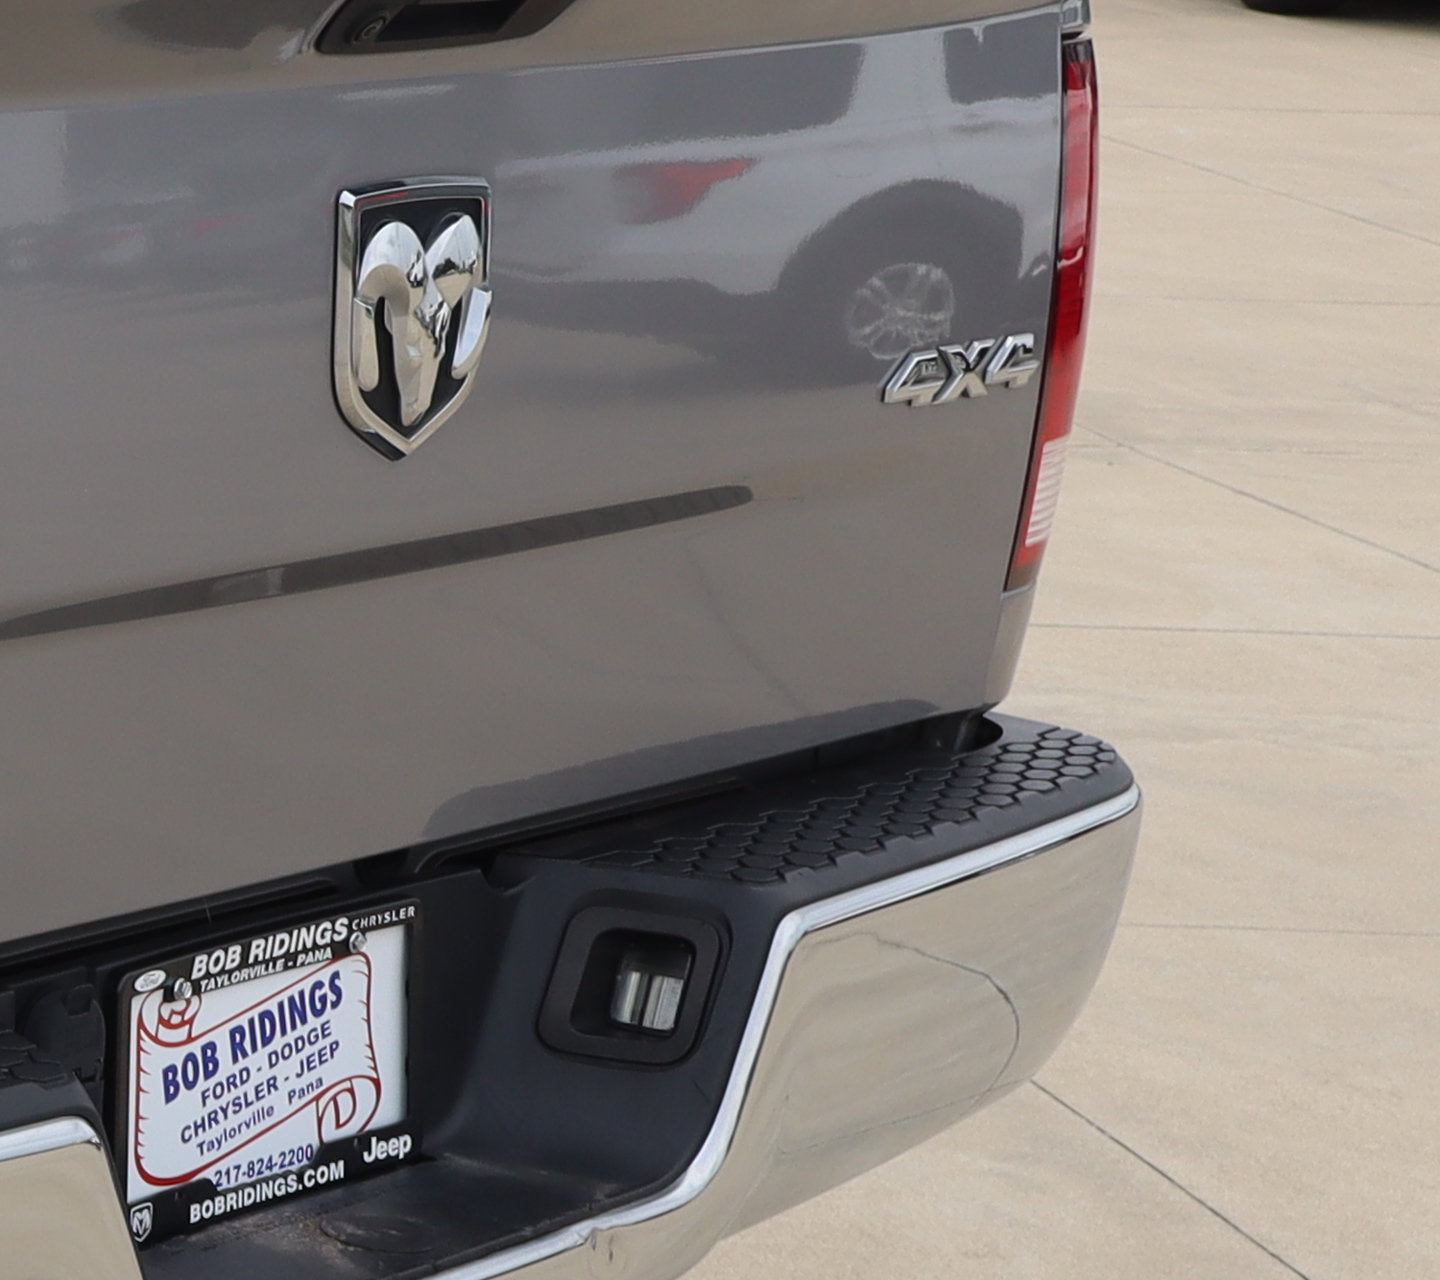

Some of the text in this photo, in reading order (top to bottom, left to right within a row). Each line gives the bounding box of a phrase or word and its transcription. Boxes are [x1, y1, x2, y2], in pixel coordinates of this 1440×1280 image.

[191, 917, 350, 980] BOB RIDINGS
[351, 905, 416, 932] CHRYSLER
[199, 961, 285, 994] TAYLORVILLE
[296, 947, 333, 968] PANA
[161, 970, 344, 1106] BOB RIDINGS
[200, 1069, 252, 1108] FORD
[267, 1019, 333, 1071] DODGE
[180, 1077, 280, 1145] CHRYSLER
[295, 1040, 341, 1079] JEEP
[196, 1076, 324, 1158] Taylorville Pana
[213, 1143, 315, 1188] 217-824-2200
[363, 1132, 413, 1164] Jeep
[189, 1159, 346, 1224] BOBRIDINGS.COM
